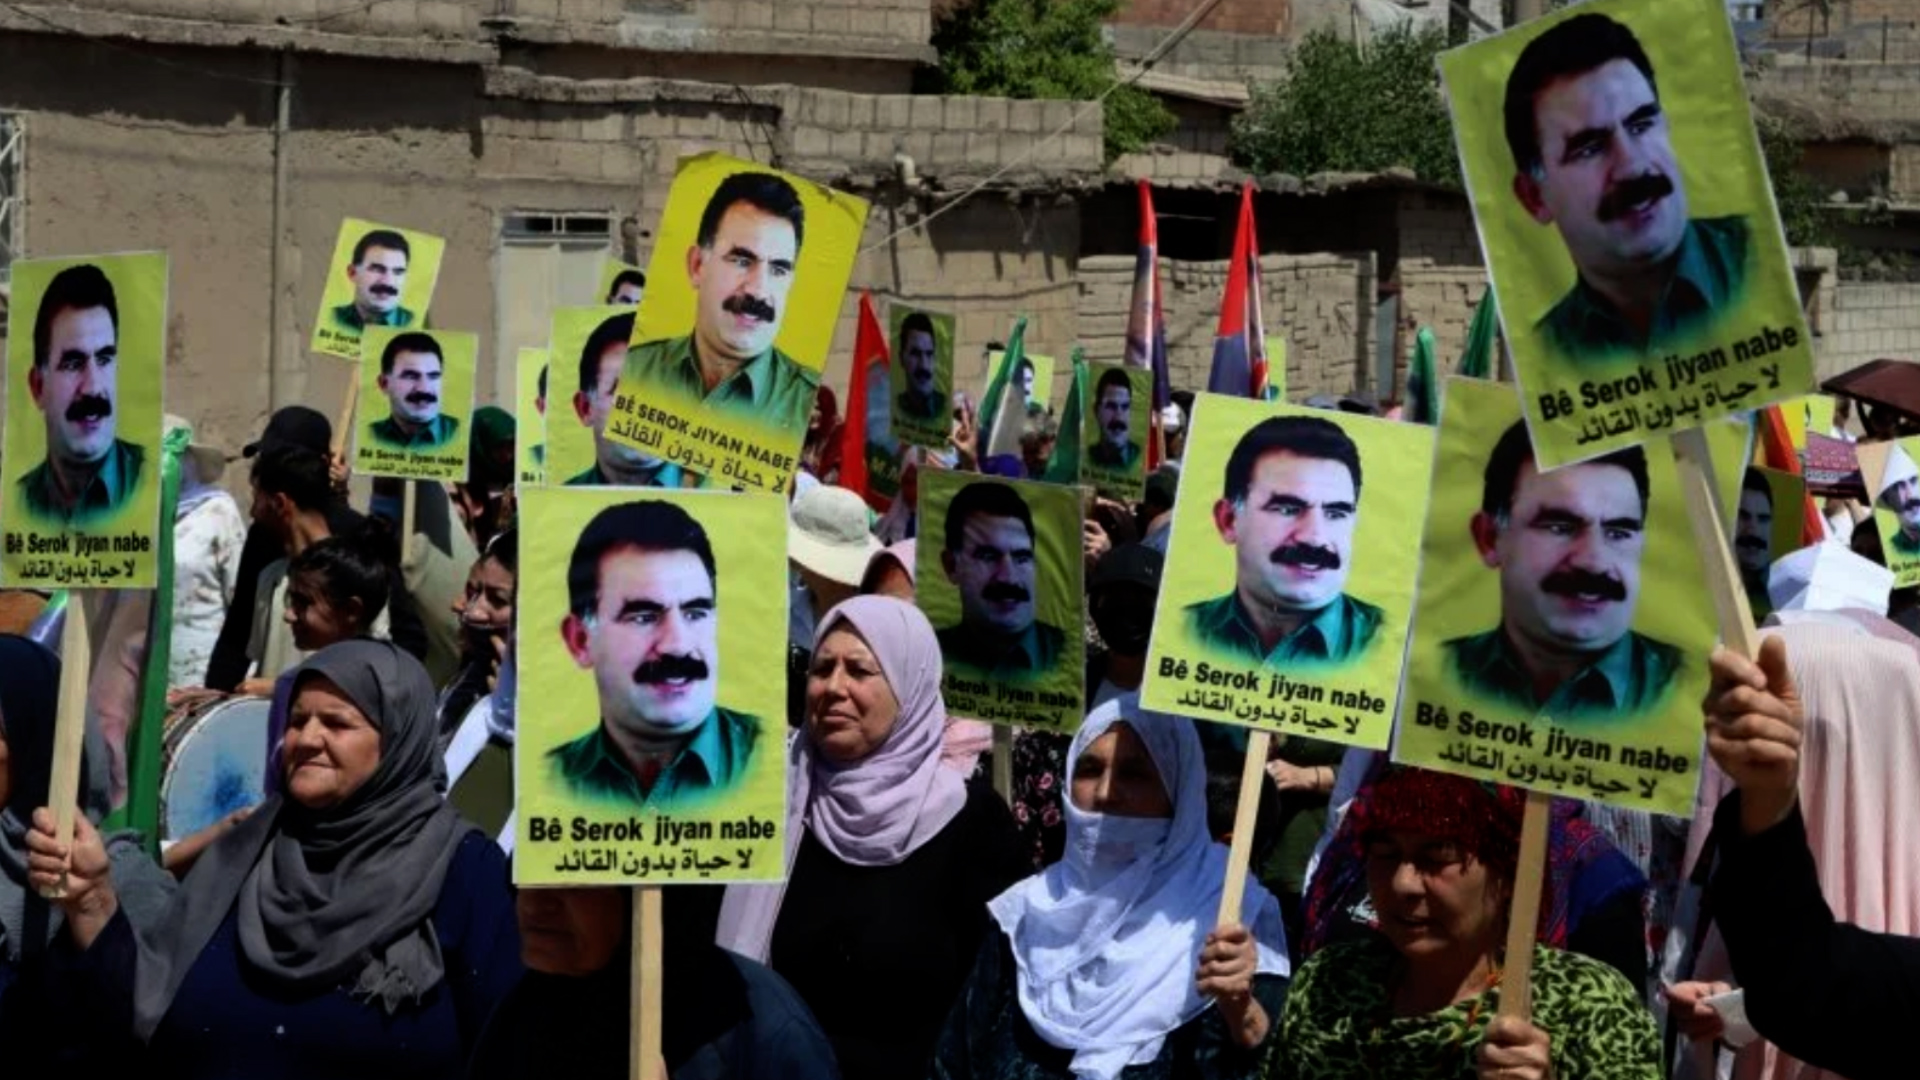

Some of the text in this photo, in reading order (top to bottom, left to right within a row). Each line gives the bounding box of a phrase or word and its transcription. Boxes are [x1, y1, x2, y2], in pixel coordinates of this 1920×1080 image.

[1538, 326, 1799, 421] Bê Serok jiyan nabe
[1577, 364, 1780, 445] لا حياة بدون القائد
[611, 418, 787, 494] لا حياة بدون القائد
[638, 403, 690, 434] SEROK
[691, 426, 743, 455] JIYAN
[745, 444, 794, 472] NABE
[19, 558, 135, 583] لا حياة بدون القائد
[27, 531, 70, 554] Serok
[75, 531, 109, 557] jiyan
[113, 530, 150, 553] nabe
[1159, 657, 1386, 714] Bê Serok jiyan nabe
[1177, 690, 1360, 734] لا حياة بدون القائد
[1415, 702, 1689, 774] Bê Serok jiyan nabe
[1438, 742, 1657, 799] لا حياة بدون القائد
[529, 816, 775, 846] Bê Serok jiyan nabe
[555, 849, 752, 877] لا حياة بدون القائد
